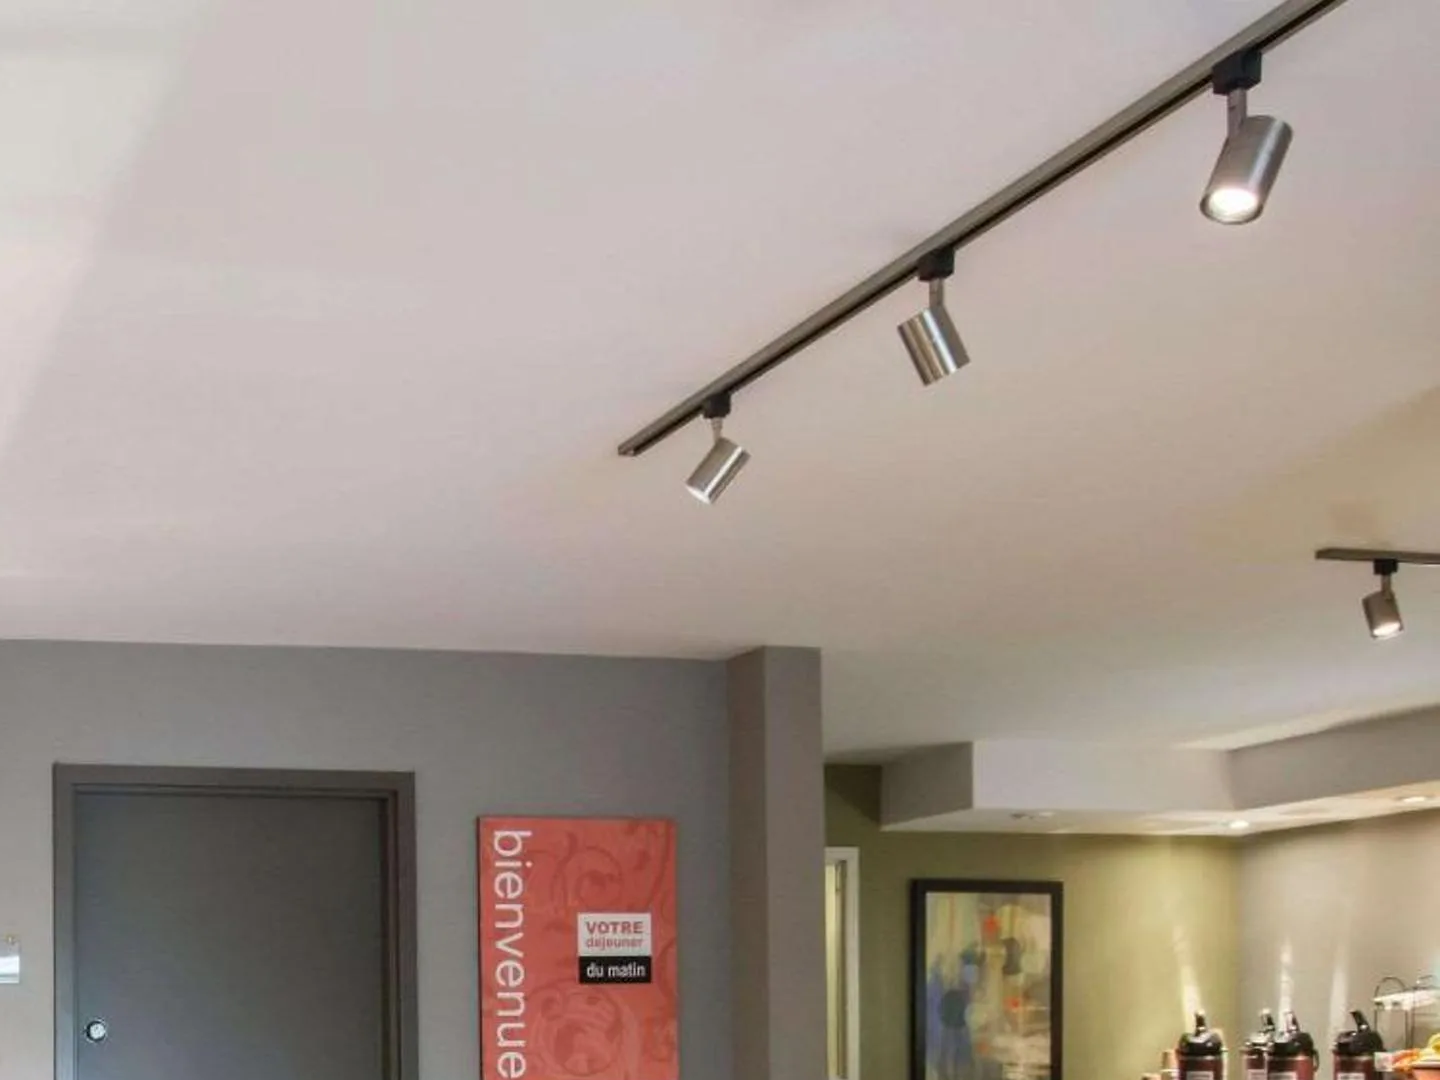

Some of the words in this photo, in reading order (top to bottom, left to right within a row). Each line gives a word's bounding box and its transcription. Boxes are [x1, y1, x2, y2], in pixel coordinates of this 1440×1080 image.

[585, 921, 644, 934] VOTRE
[494, 830, 532, 1079] bienvenue
[587, 962, 604, 978] du
[608, 961, 646, 978] matin
